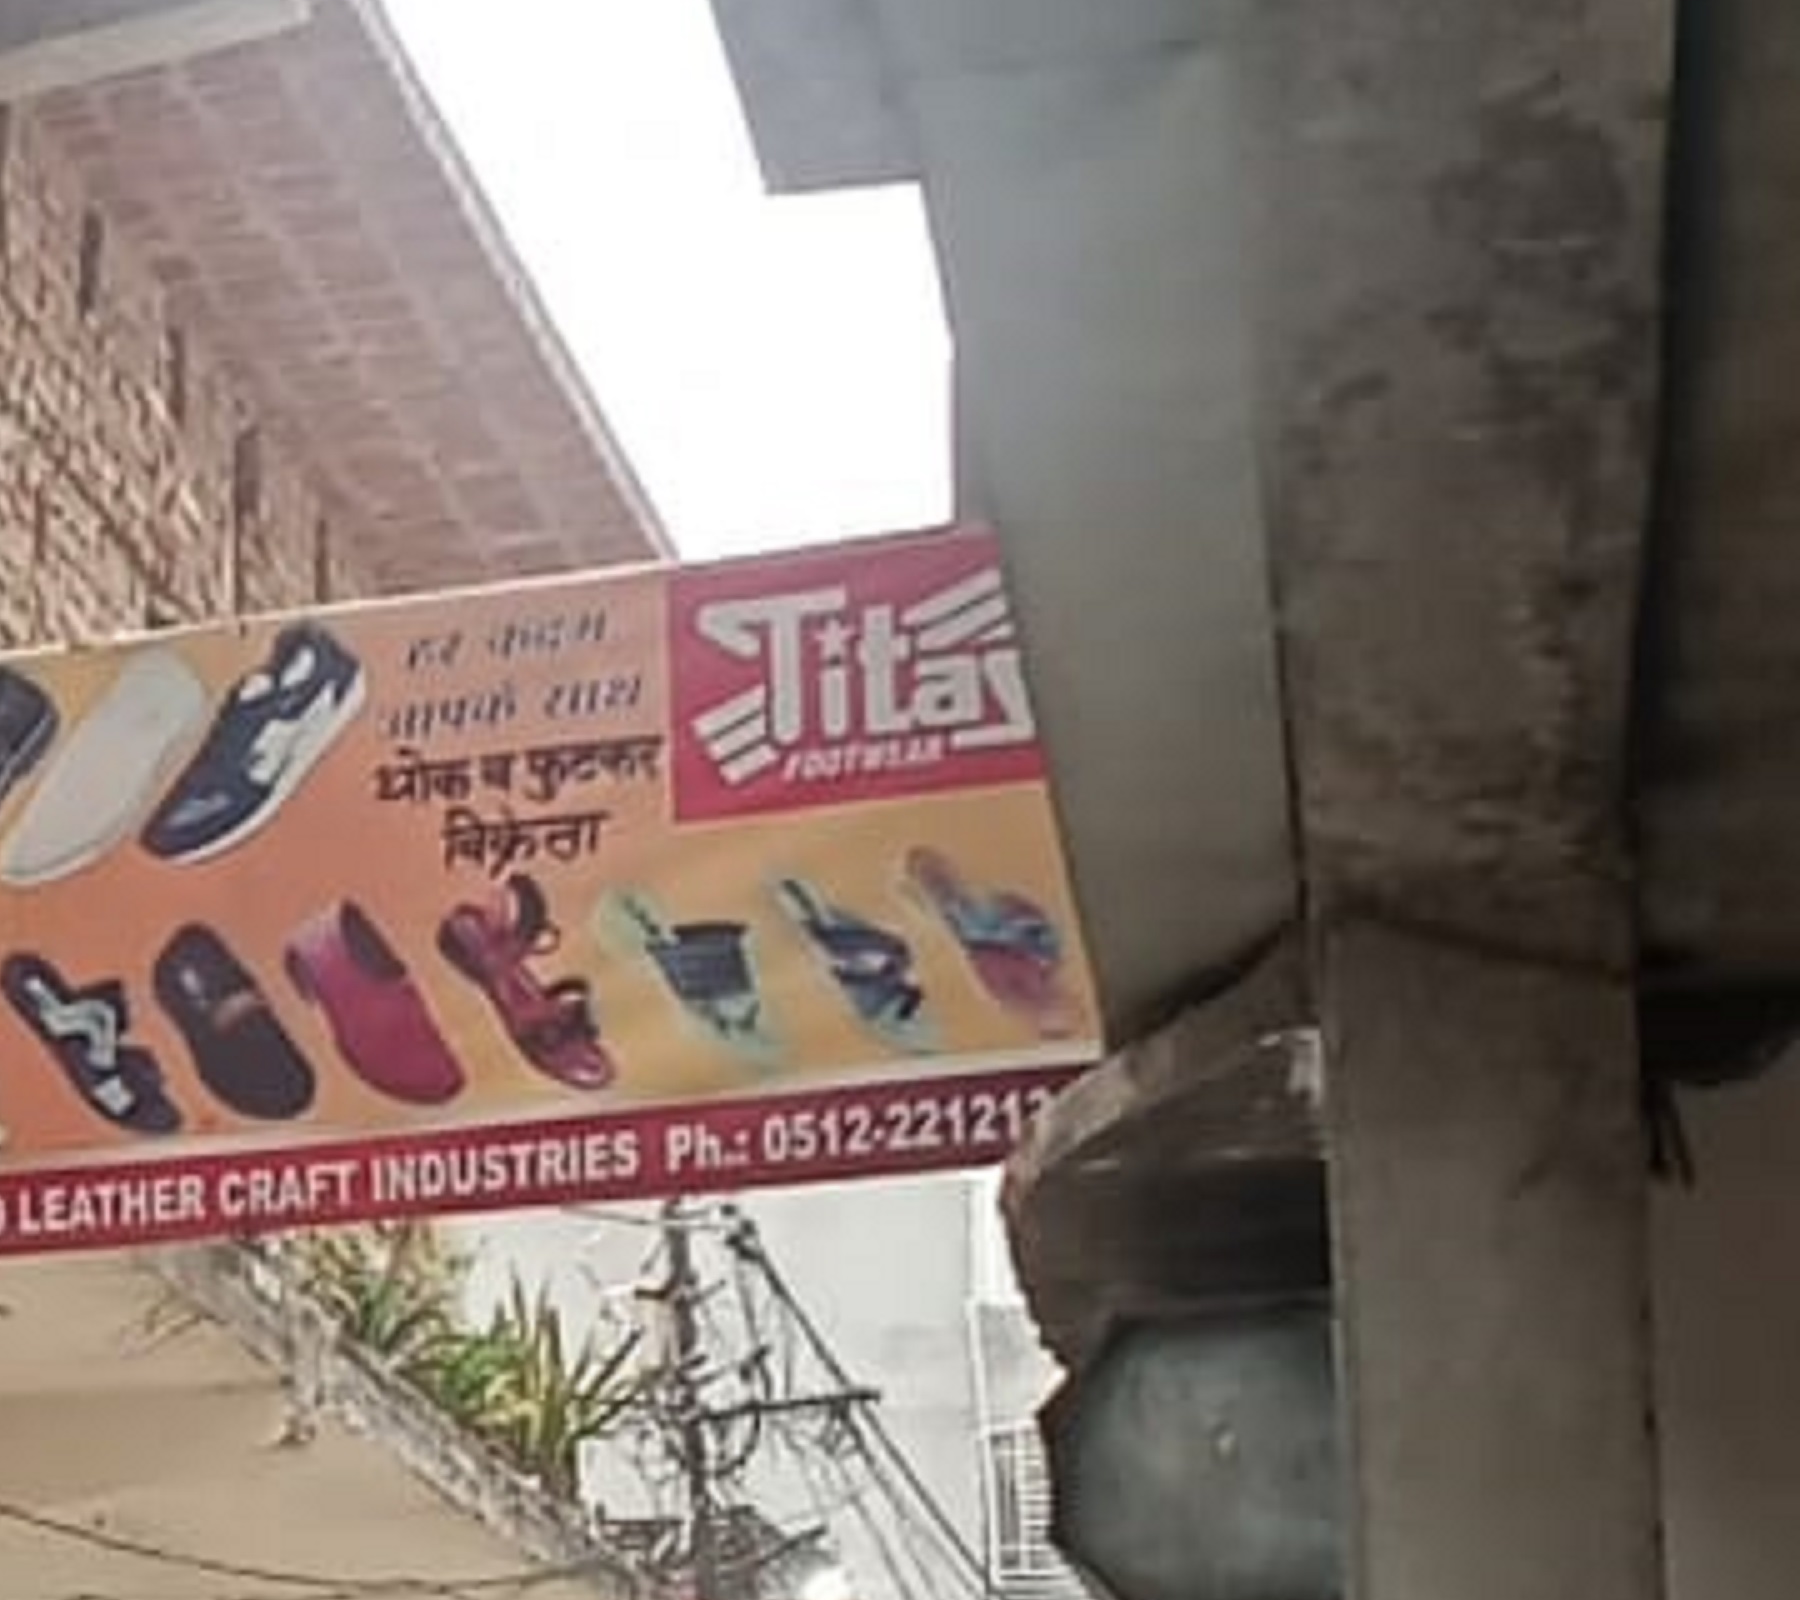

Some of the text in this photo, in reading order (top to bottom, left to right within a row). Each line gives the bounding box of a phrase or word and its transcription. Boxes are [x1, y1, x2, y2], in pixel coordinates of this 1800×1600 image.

[780, 732, 945, 782] FOOTWEAR
[17, 1171, 208, 1236] LEATHER
[217, 1159, 361, 1218] CRAFT
[370, 1128, 642, 1204] INDUSTRIES
